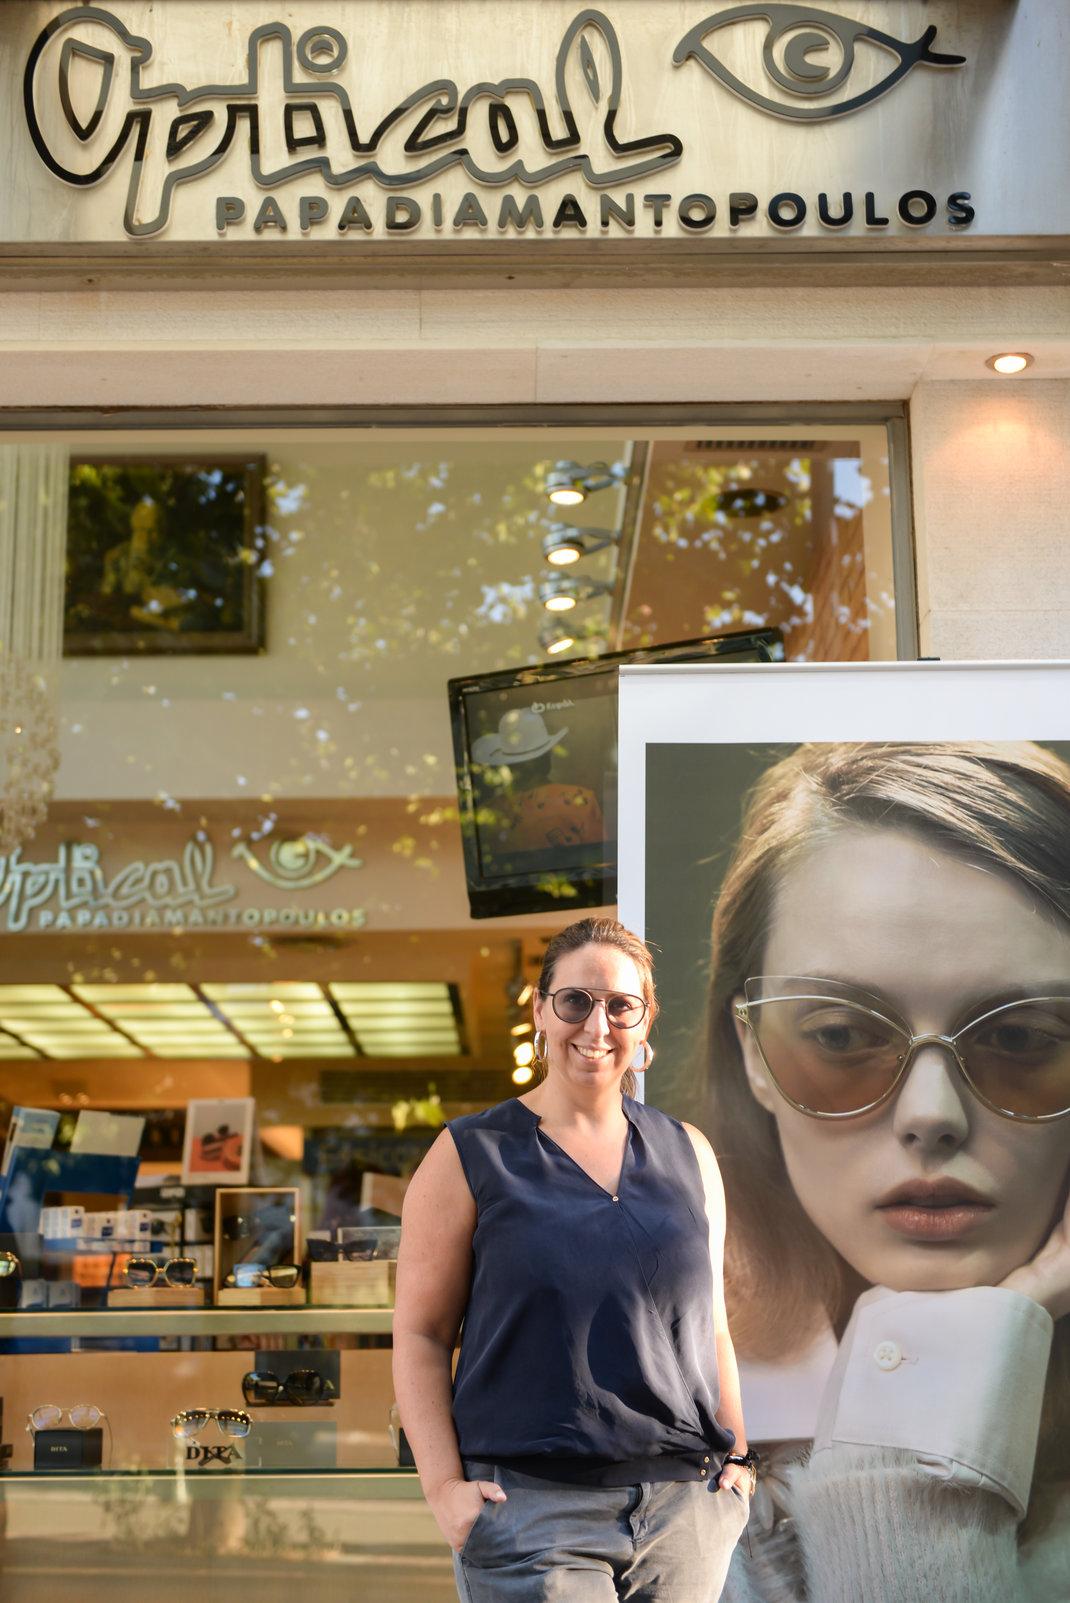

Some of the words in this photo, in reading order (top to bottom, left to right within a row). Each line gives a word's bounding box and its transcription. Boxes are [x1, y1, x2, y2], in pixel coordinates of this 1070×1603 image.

[24, 7, 684, 237] Optical
[215, 191, 976, 232] PAPADIAMANTOPOULOS
[38, 907, 367, 929] PAPADIAMANTOPOULOS
